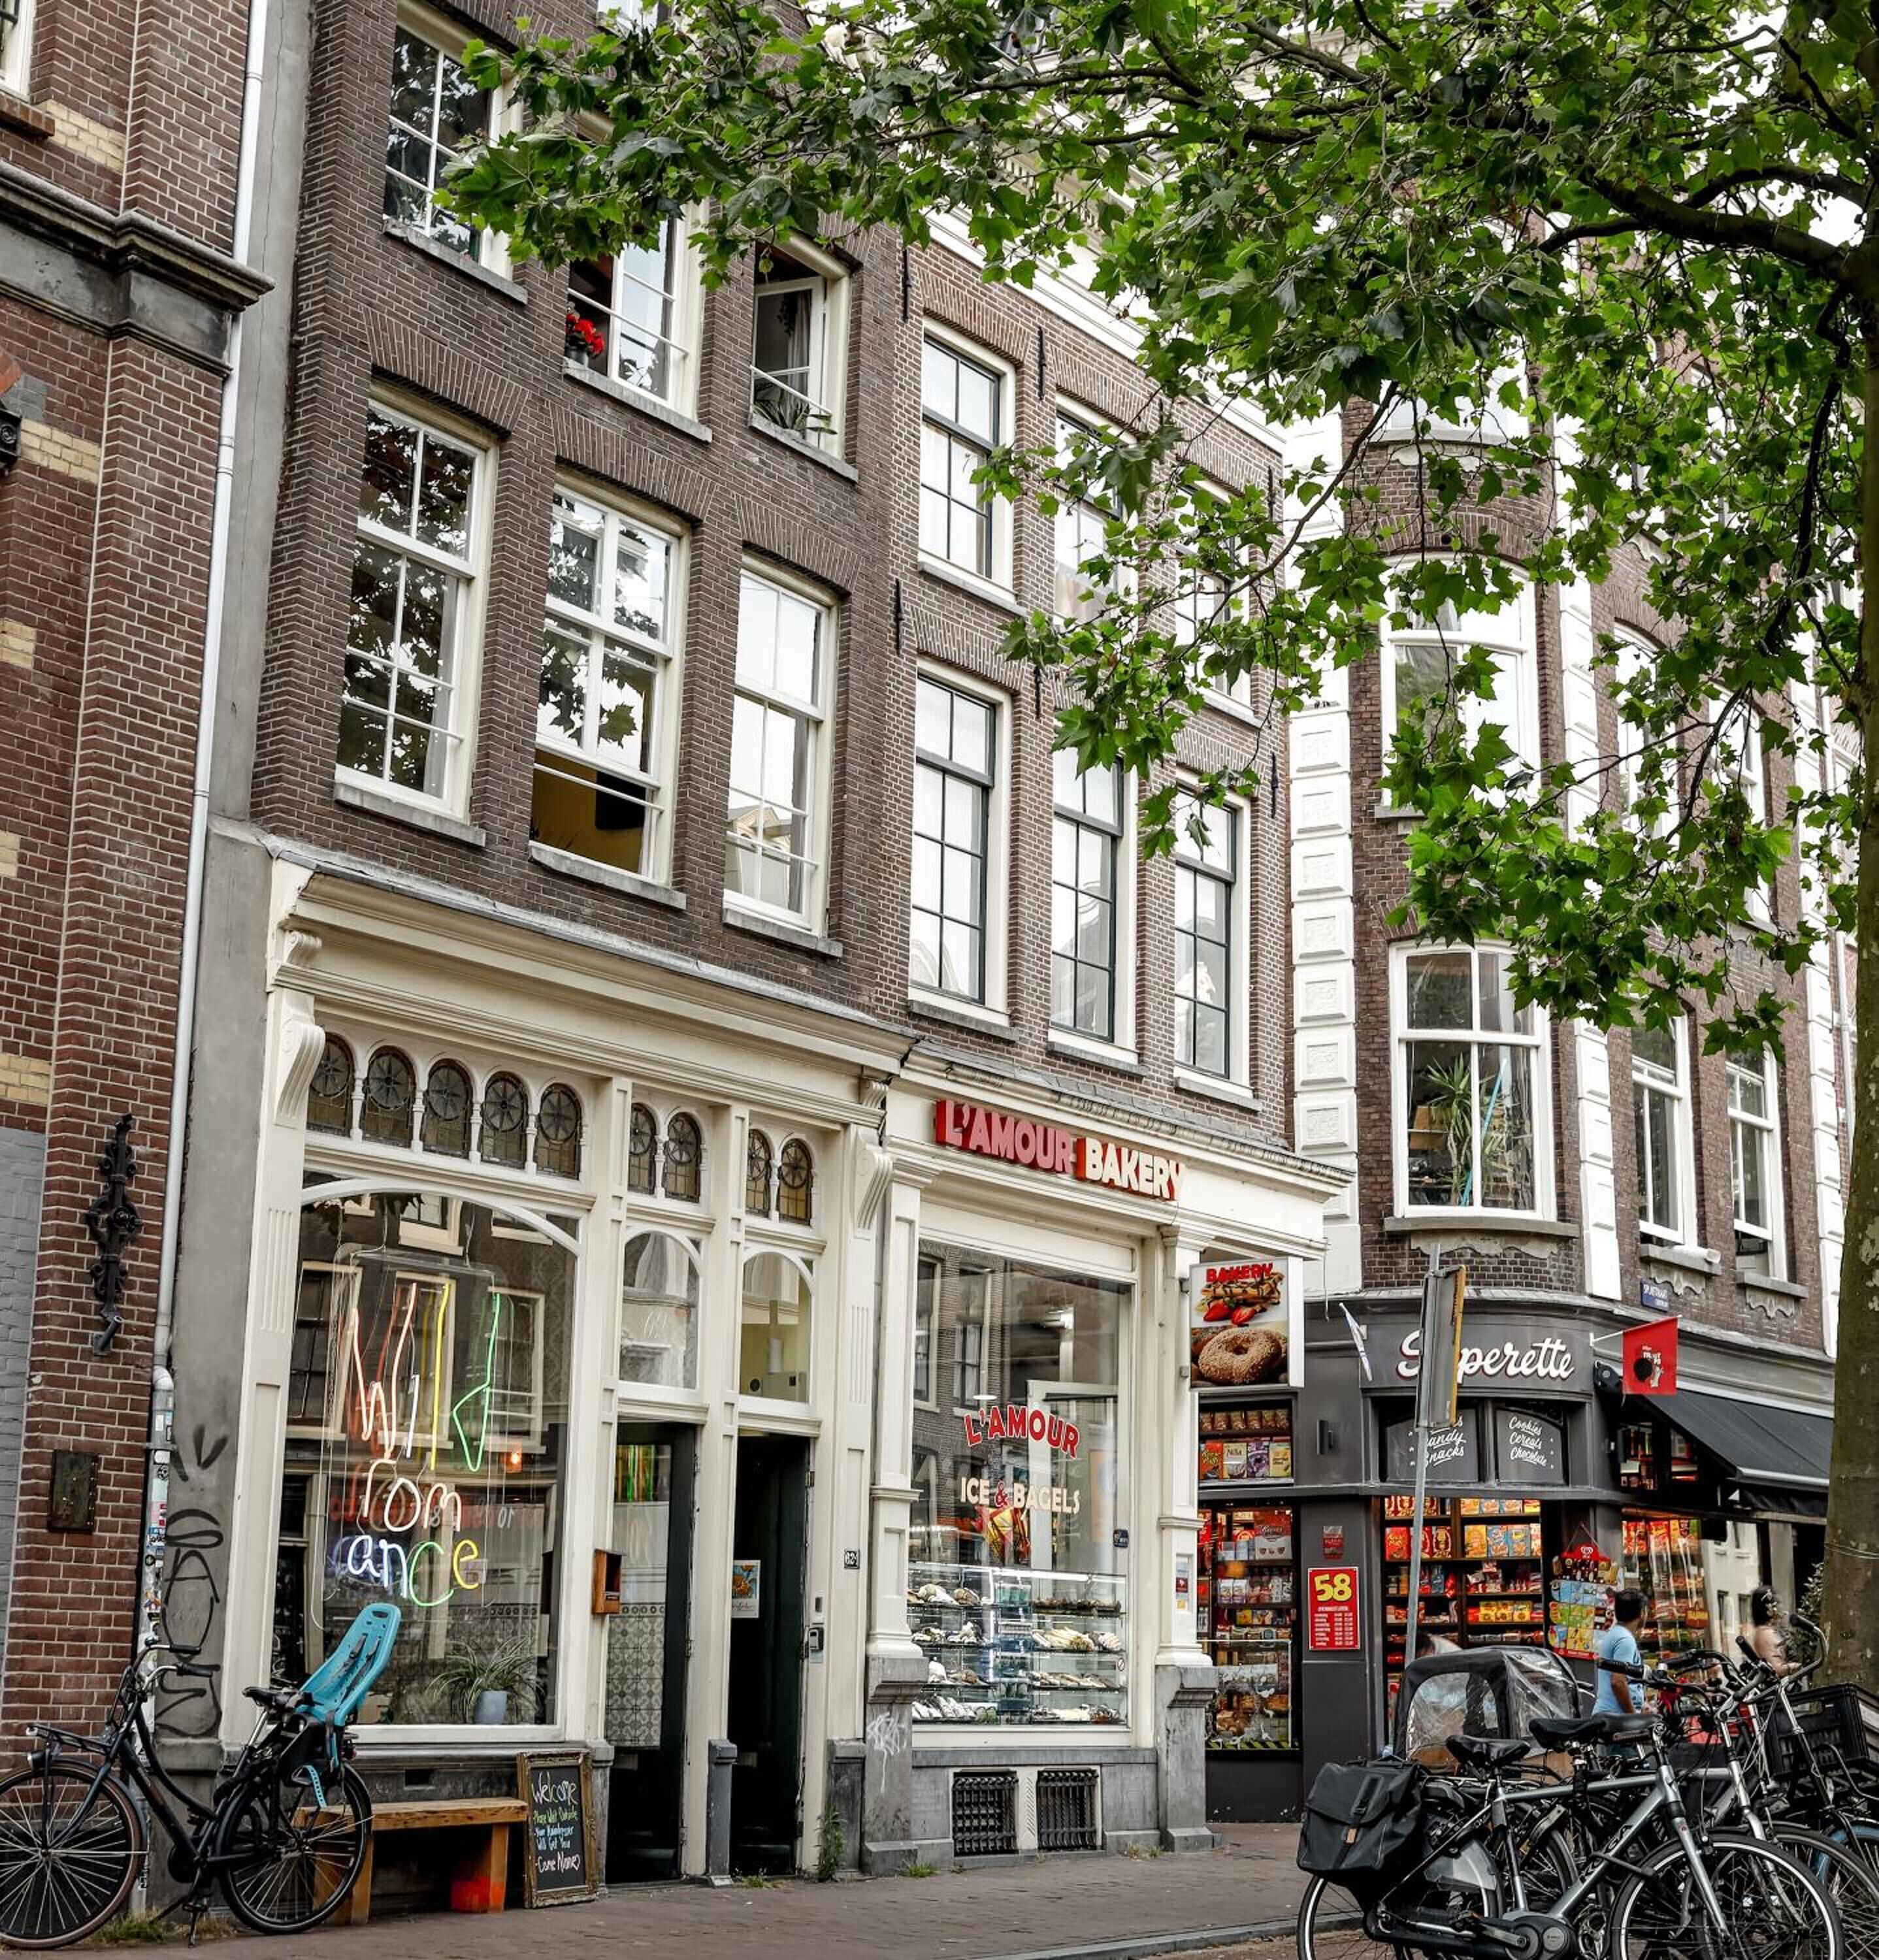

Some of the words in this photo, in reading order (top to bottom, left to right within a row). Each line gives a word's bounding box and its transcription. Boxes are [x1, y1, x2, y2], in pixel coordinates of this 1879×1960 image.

[937, 1100, 1074, 1174] L'AMOUR
[1077, 1137, 1185, 1201] BAKERY
[1206, 1262, 1273, 1282] BAKERY
[1397, 1329, 1575, 1384] Sperette
[964, 1405, 1080, 1460] L'AMOUR
[1426, 1429, 1467, 1446] andy
[1509, 1416, 1542, 1436] Cookies
[1510, 1431, 1543, 1450] Cereals
[1511, 1446, 1547, 1467] Chocolate
[960, 1477, 990, 1505] ICE
[994, 1480, 1009, 1508] &
[1013, 1482, 1081, 1515] BAGELS
[1314, 1573, 1352, 1602] 58
